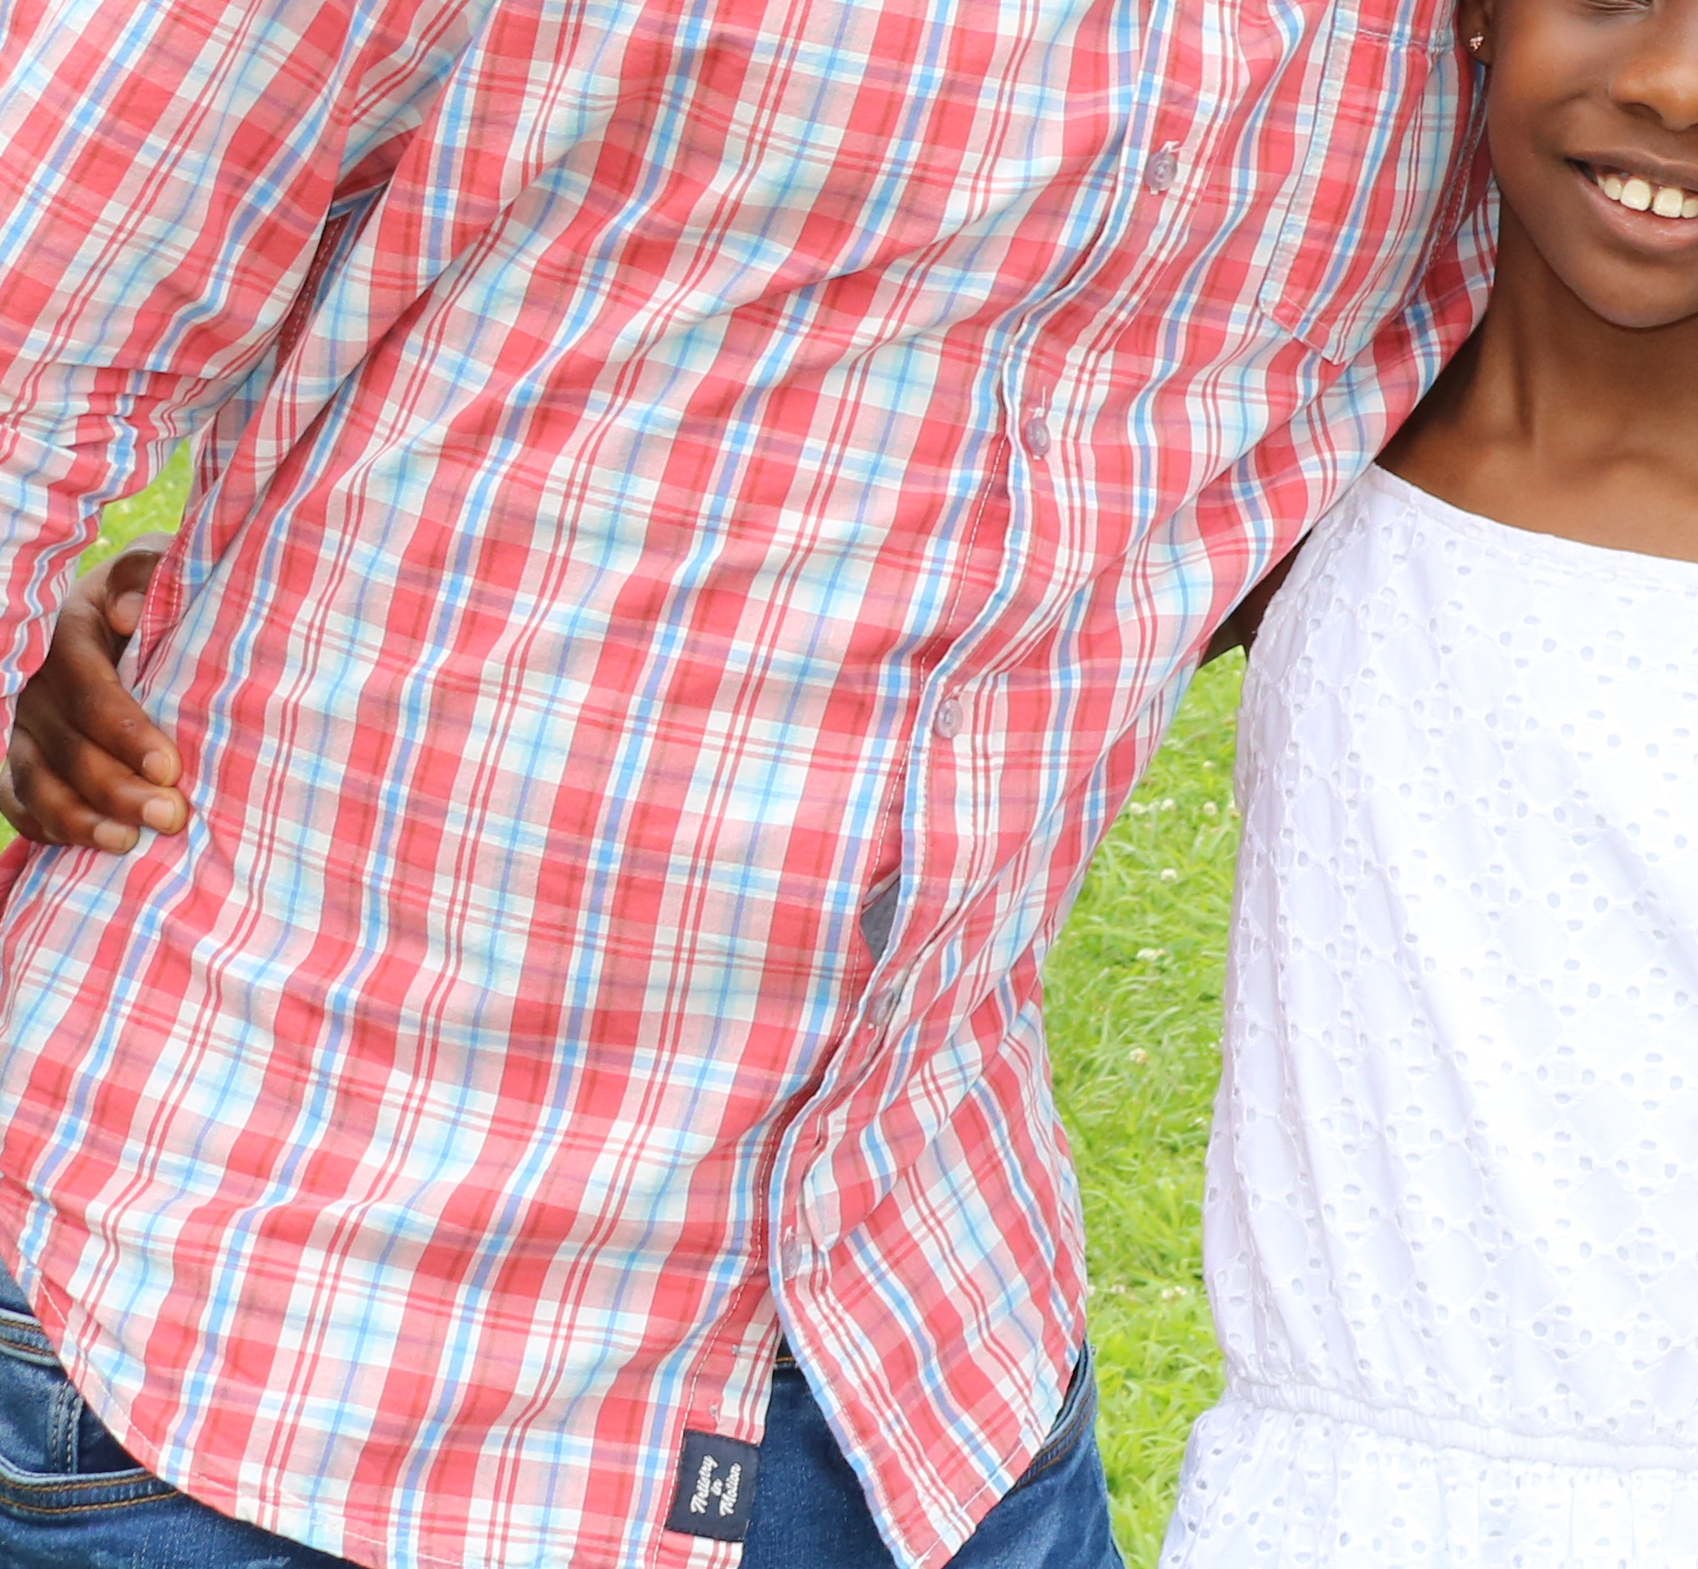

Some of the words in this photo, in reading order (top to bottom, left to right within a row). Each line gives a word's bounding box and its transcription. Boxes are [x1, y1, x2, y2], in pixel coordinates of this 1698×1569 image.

[689, 1454, 719, 1515] Artistry
[710, 1478, 723, 1497] in
[718, 1462, 743, 1517] Motion
